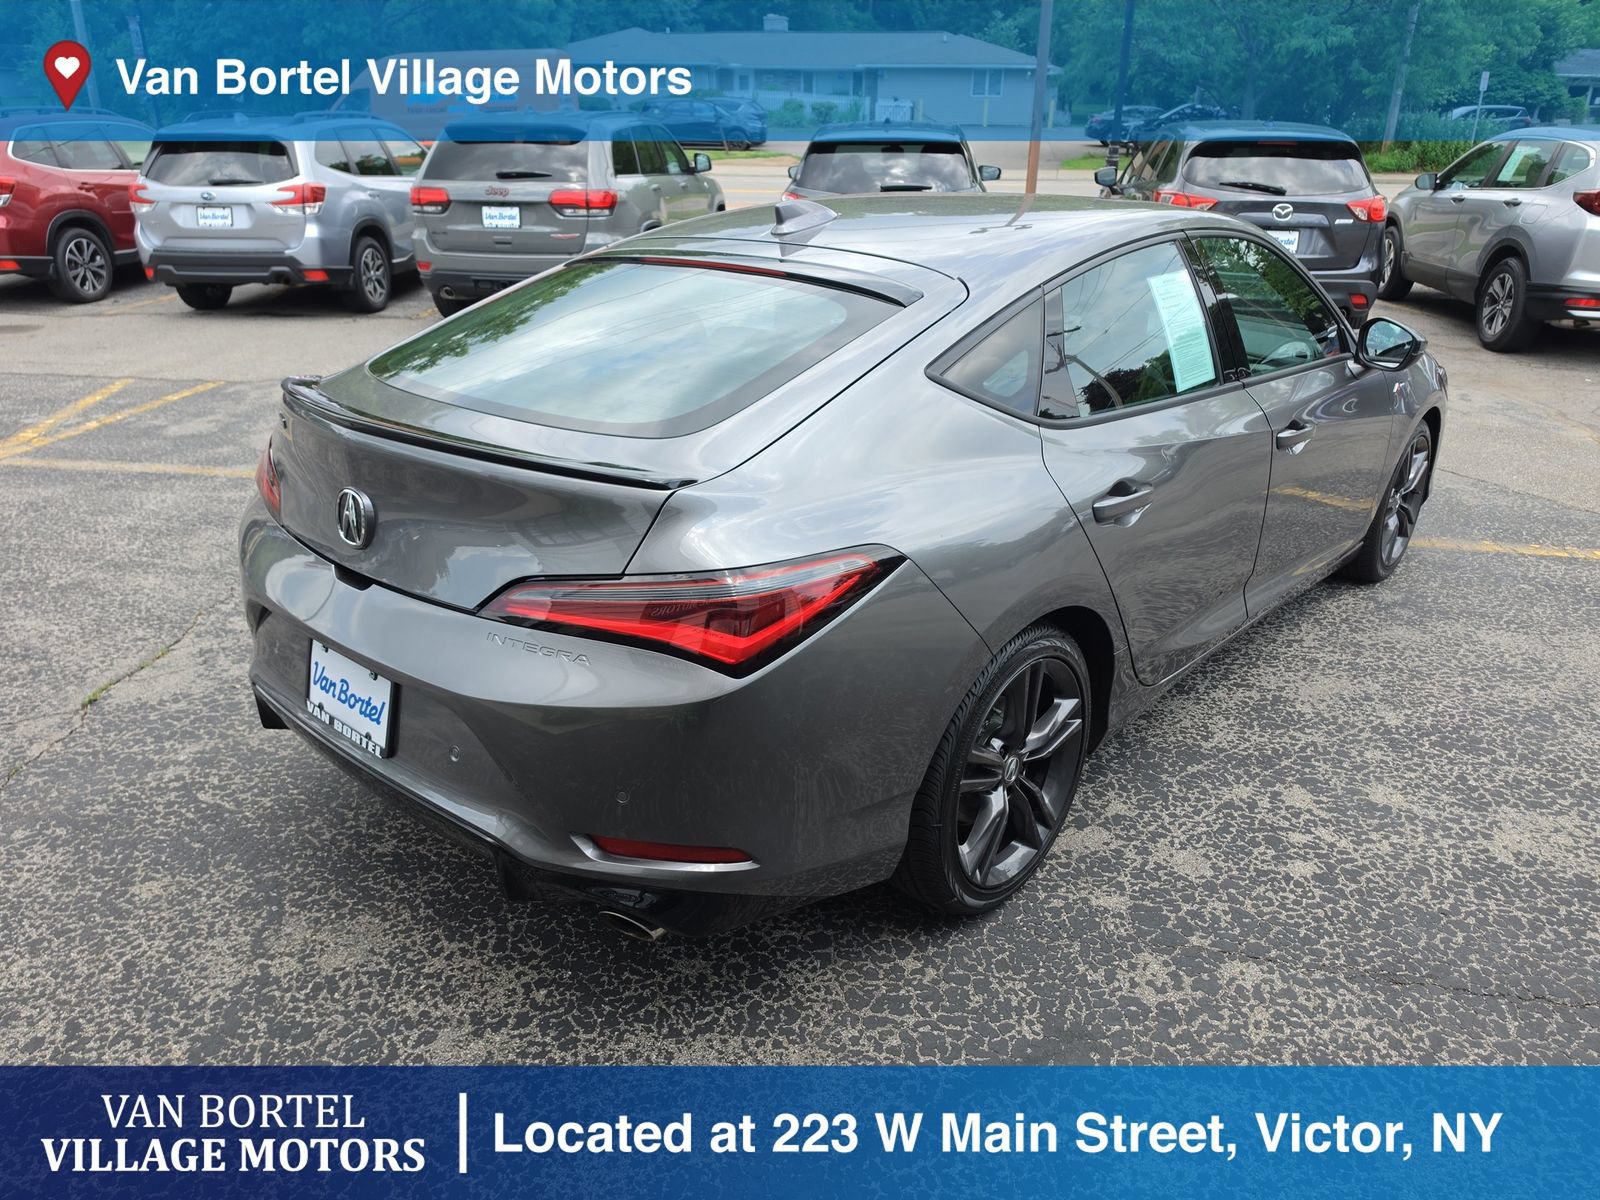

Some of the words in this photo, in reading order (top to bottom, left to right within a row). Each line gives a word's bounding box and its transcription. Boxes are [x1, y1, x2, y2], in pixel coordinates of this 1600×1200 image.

[486, 631, 592, 667] INTEGRA
[313, 661, 337, 699] Van
[337, 678, 386, 726] Bortel
[306, 697, 331, 725] VAN
[333, 718, 383, 759] BORTEL
